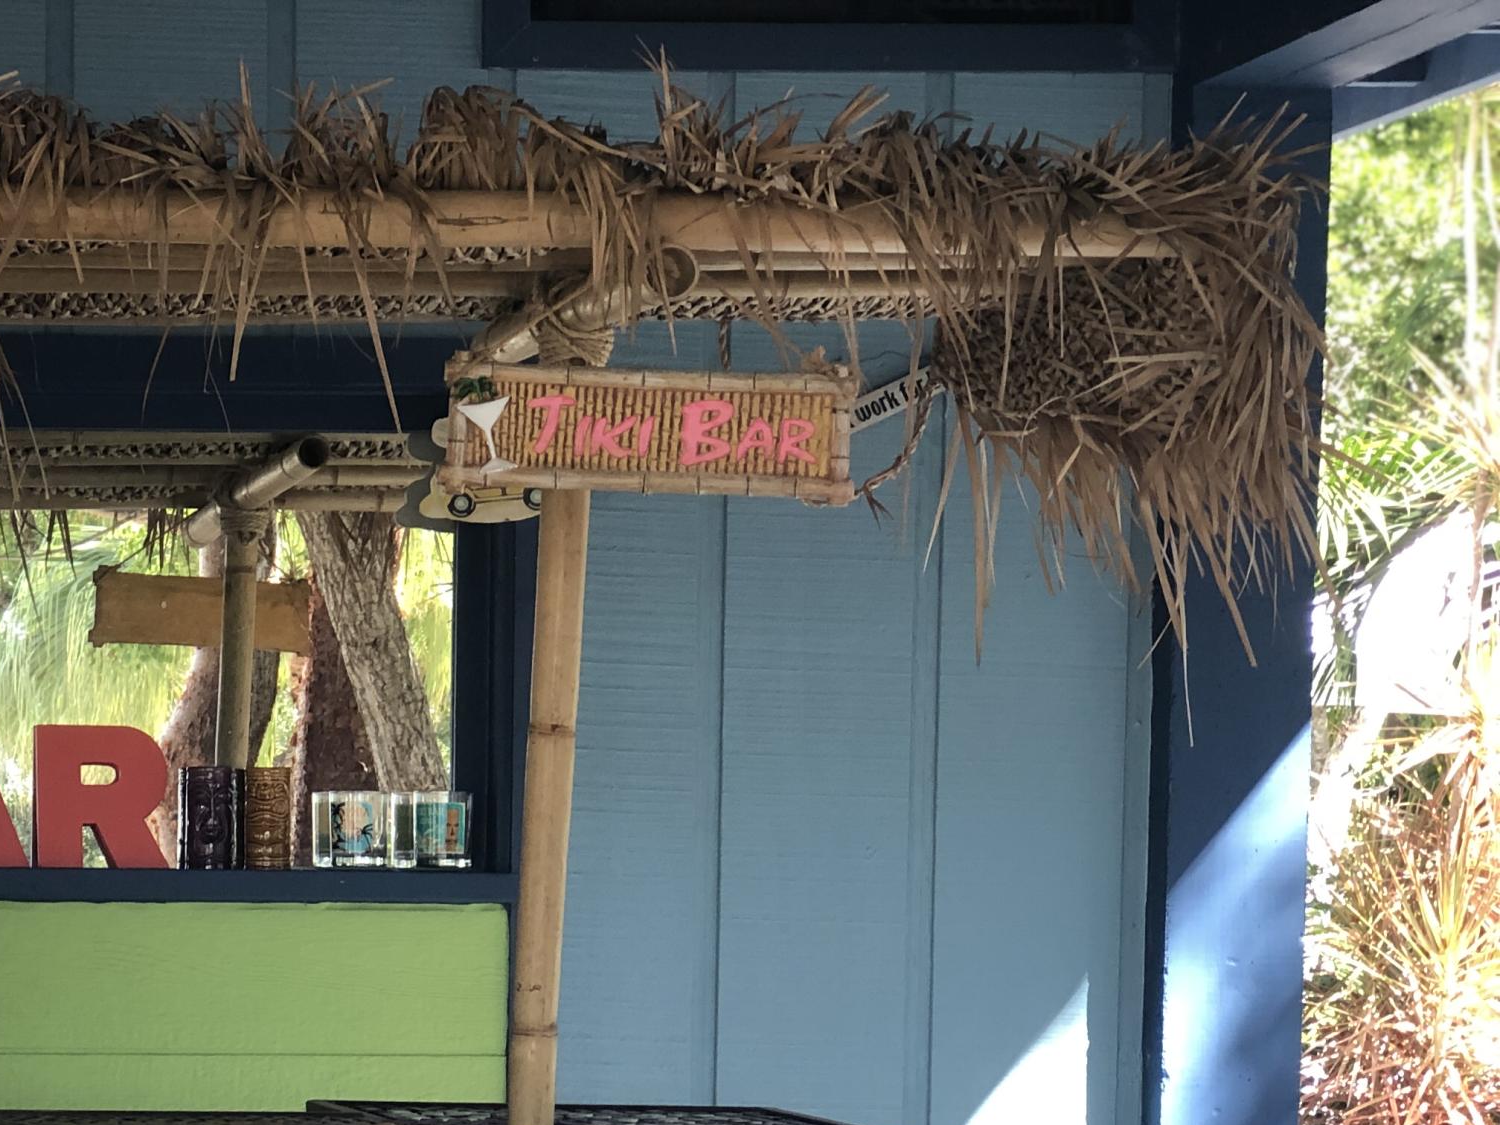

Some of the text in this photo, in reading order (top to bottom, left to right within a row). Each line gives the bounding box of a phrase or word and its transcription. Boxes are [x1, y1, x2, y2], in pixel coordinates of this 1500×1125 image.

[526, 394, 816, 466] TIKI BAR
[854, 390, 901, 422] work
